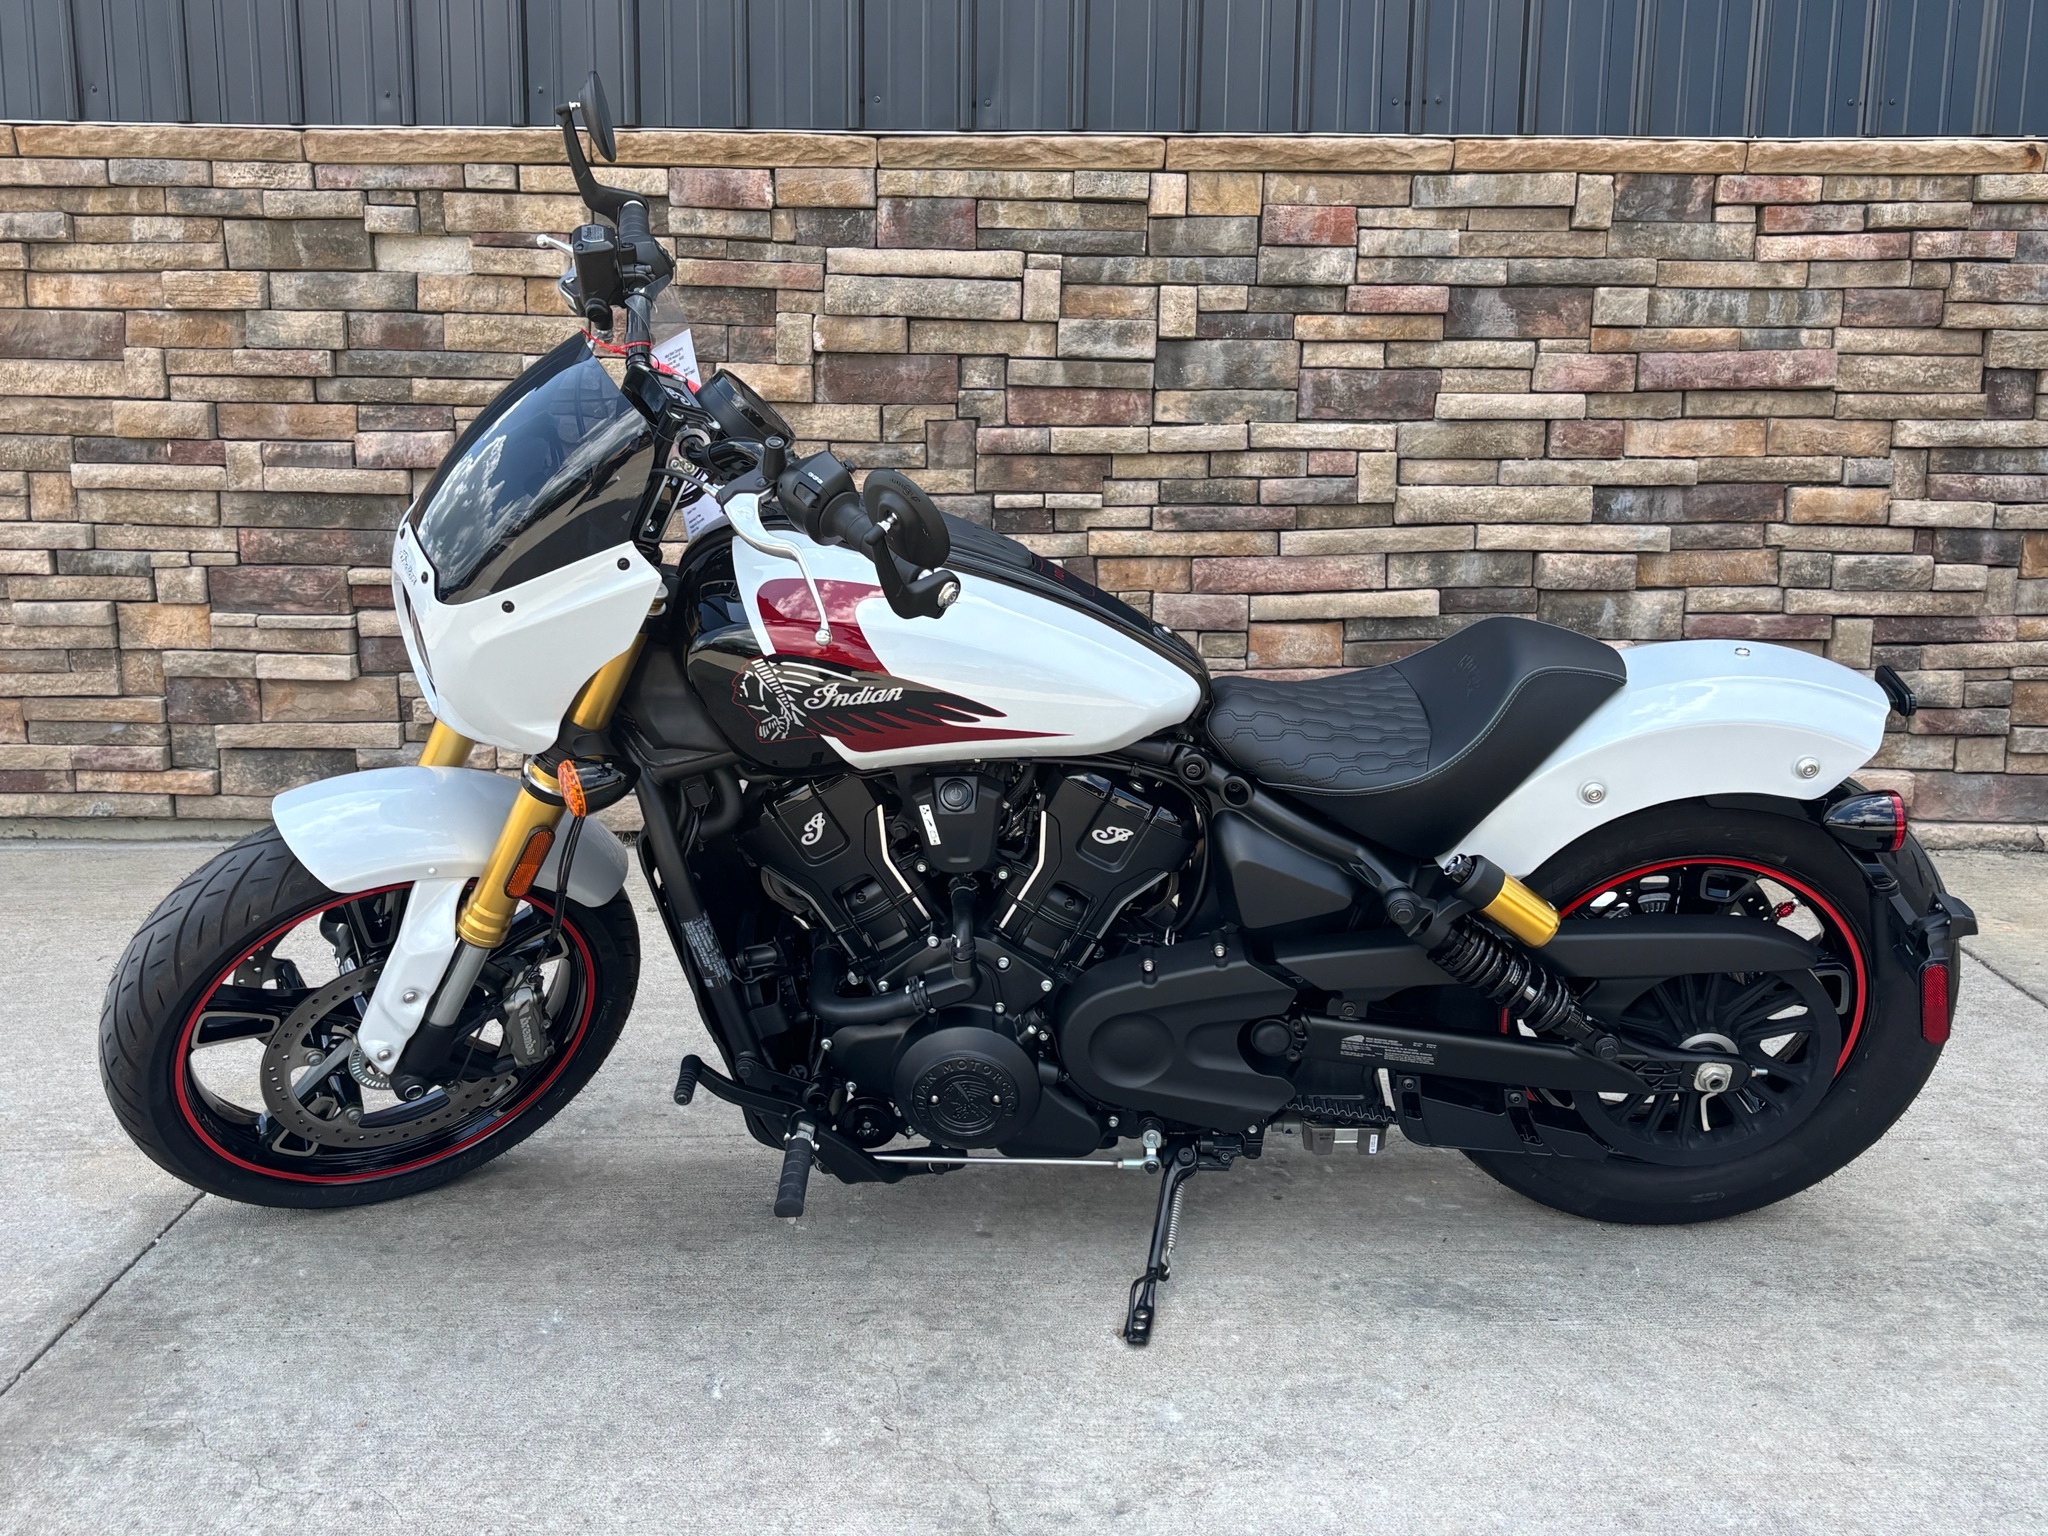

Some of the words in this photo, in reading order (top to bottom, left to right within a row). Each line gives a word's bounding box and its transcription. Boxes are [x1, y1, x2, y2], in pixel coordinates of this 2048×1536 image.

[803, 681, 904, 710] Indian
[519, 1015, 537, 1056] brembo
[915, 1072, 938, 1123] NDIAN
[942, 1059, 1017, 1121] MOTORCYCL
